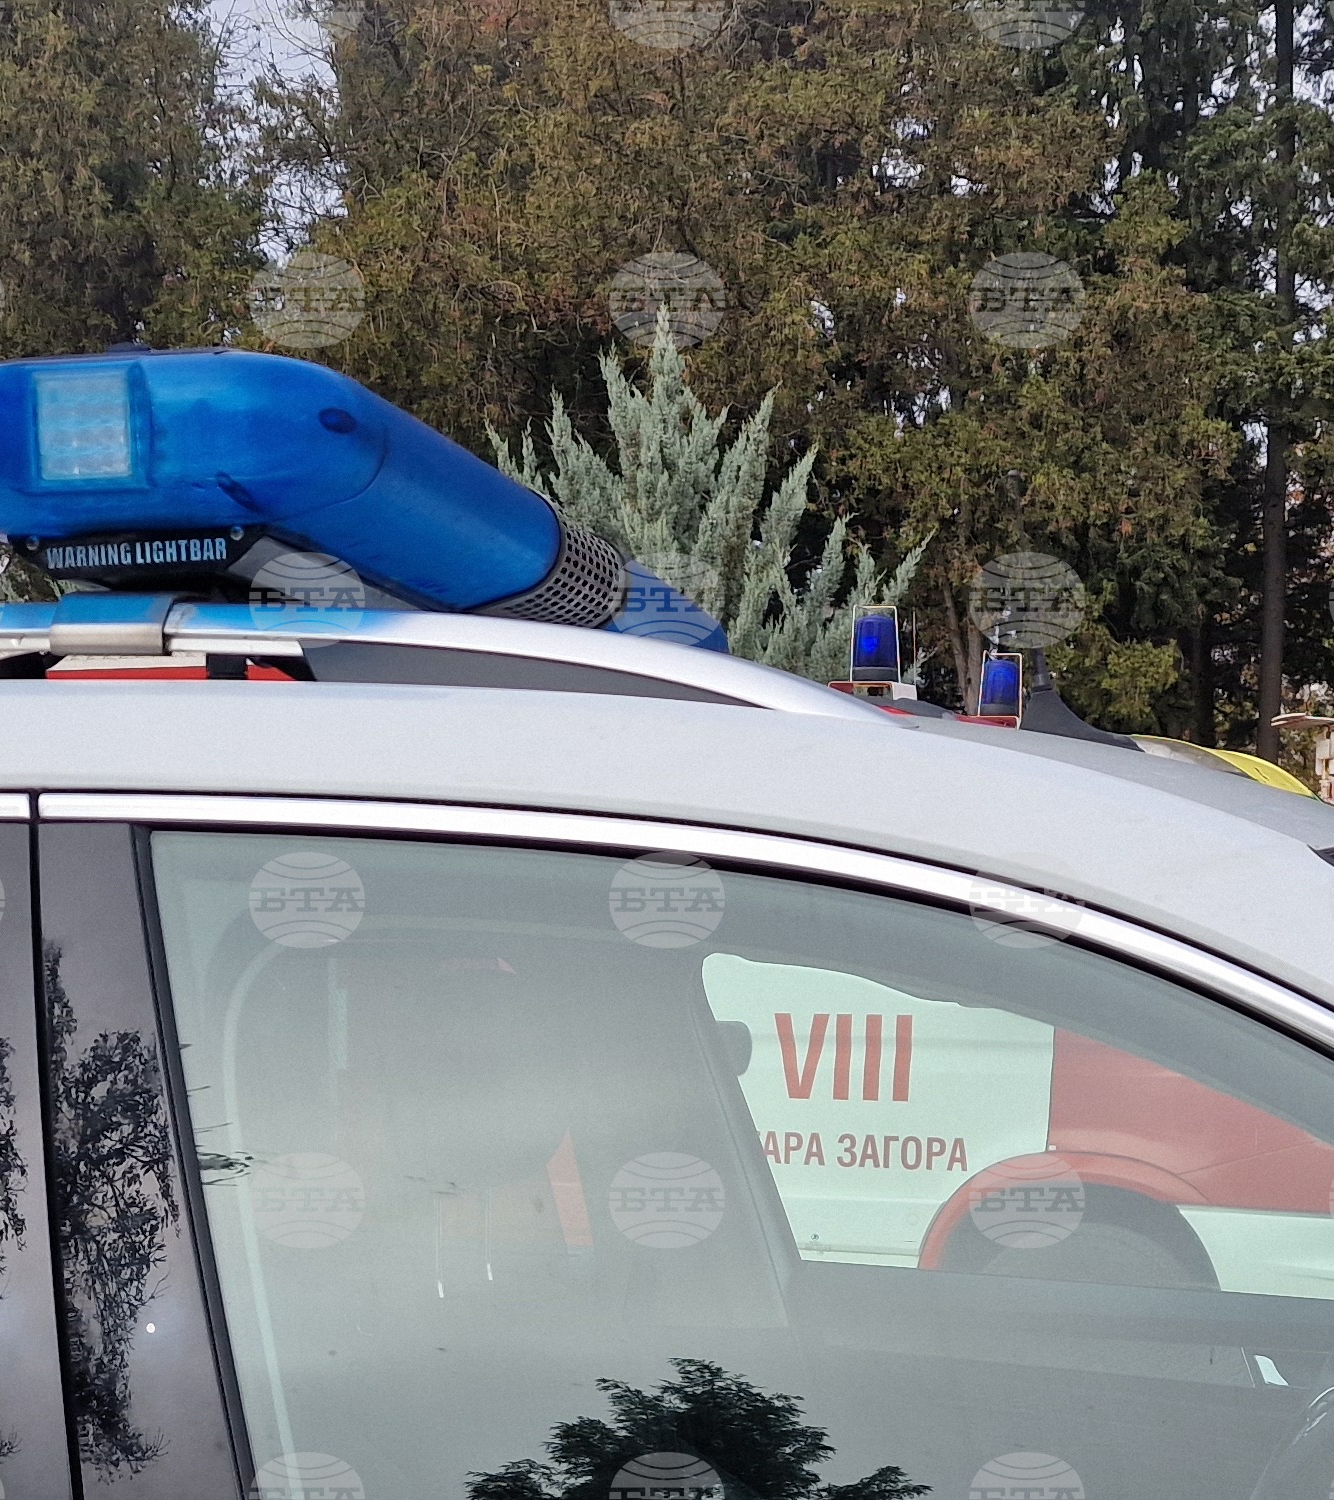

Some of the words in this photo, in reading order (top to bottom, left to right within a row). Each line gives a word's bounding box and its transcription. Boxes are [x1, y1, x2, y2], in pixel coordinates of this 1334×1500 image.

[46, 542, 132, 569] WARNING
[135, 537, 227, 565] LIGHTBAR
[774, 1012, 913, 1102] VIII
[758, 1131, 825, 1166] АРА
[836, 1133, 968, 1172] ЗАГОРА
